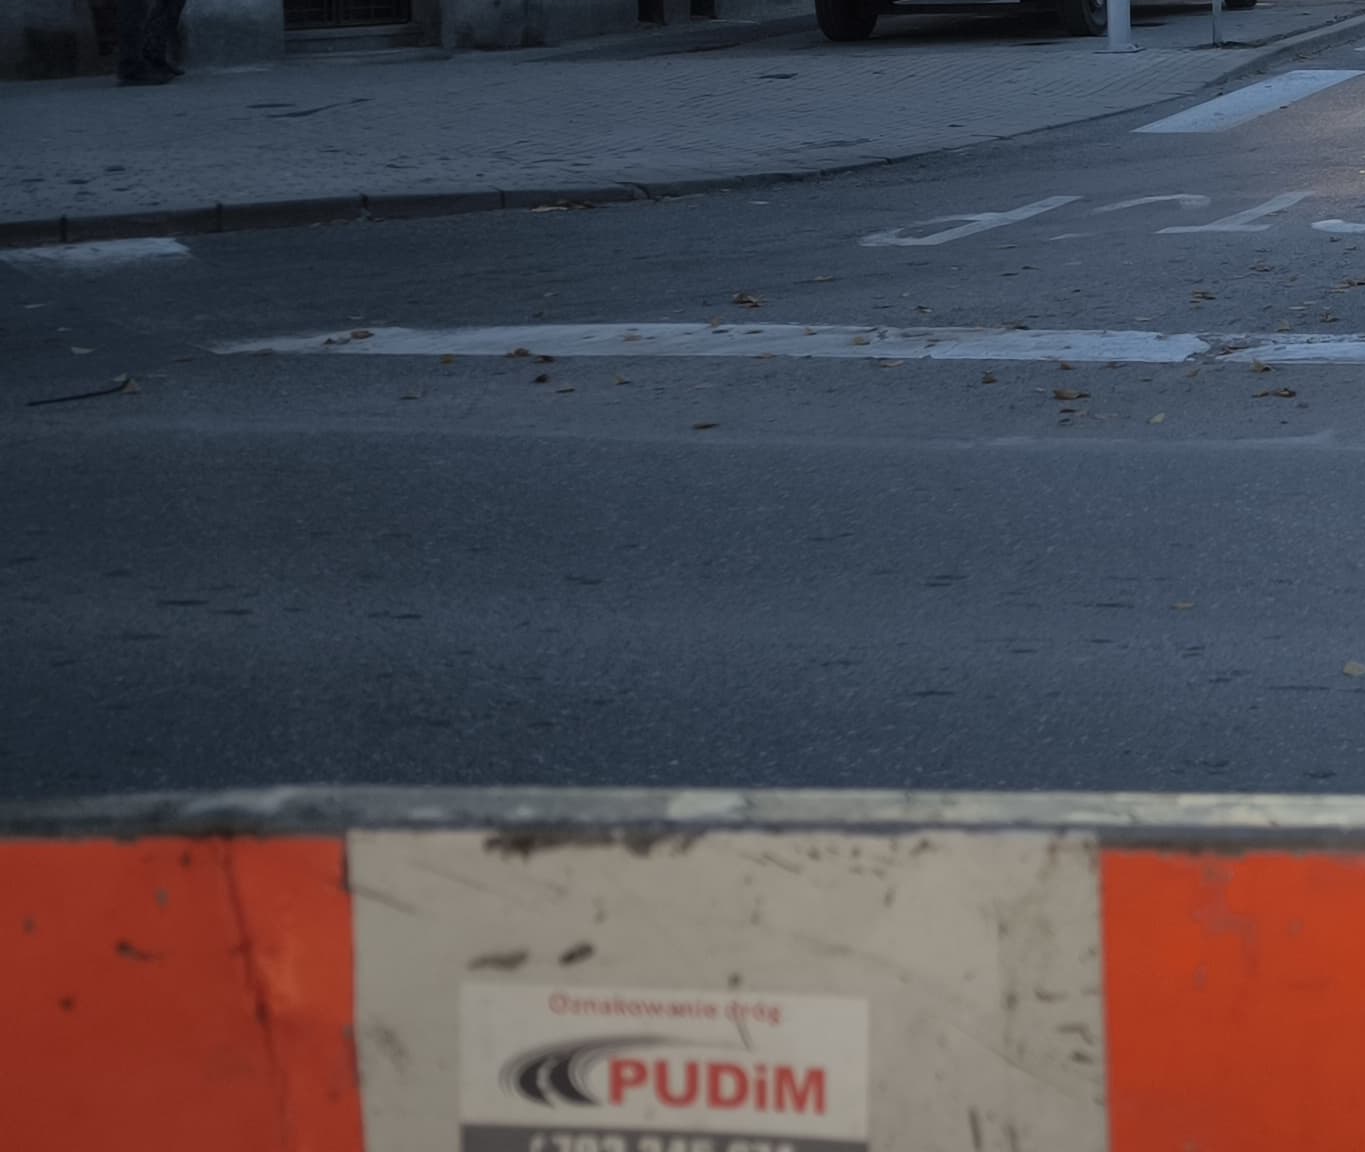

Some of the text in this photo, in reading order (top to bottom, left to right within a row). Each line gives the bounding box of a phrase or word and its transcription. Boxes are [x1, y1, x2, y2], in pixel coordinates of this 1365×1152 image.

[548, 993, 782, 1027] Oznakowanie dróg
[608, 1057, 828, 1116] PUDiM
